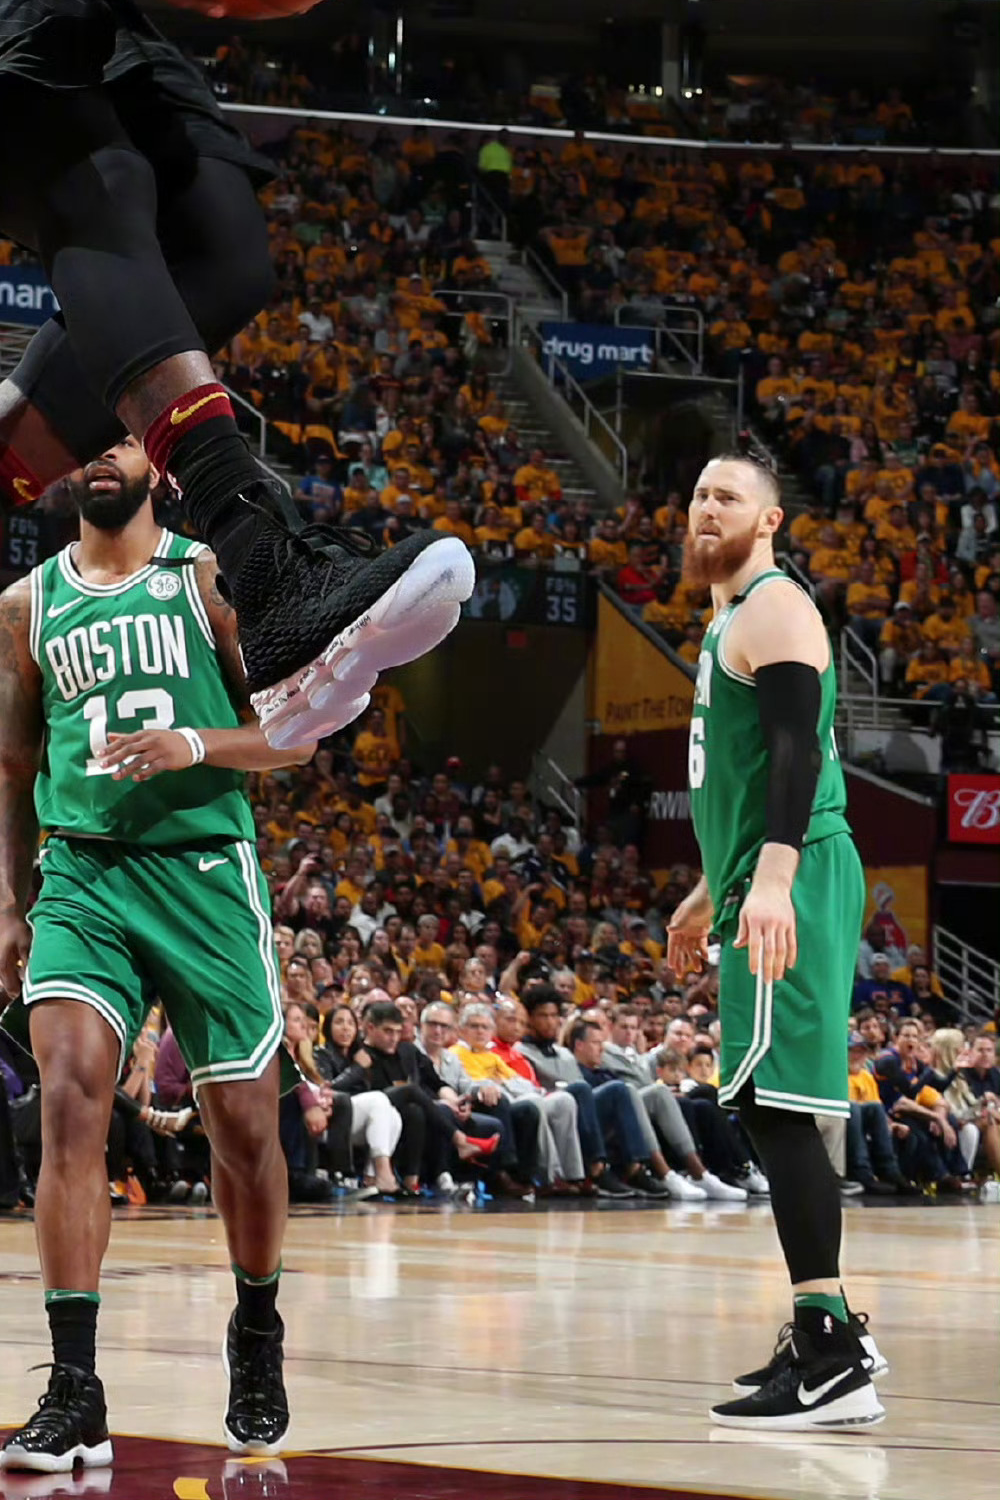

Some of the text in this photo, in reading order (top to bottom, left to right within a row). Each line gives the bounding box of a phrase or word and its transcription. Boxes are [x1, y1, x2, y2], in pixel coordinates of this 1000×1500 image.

[543, 335, 654, 364] drug mart
[9, 538, 39, 566] 53
[546, 595, 577, 623] 35
[45, 614, 190, 702] BOSTON
